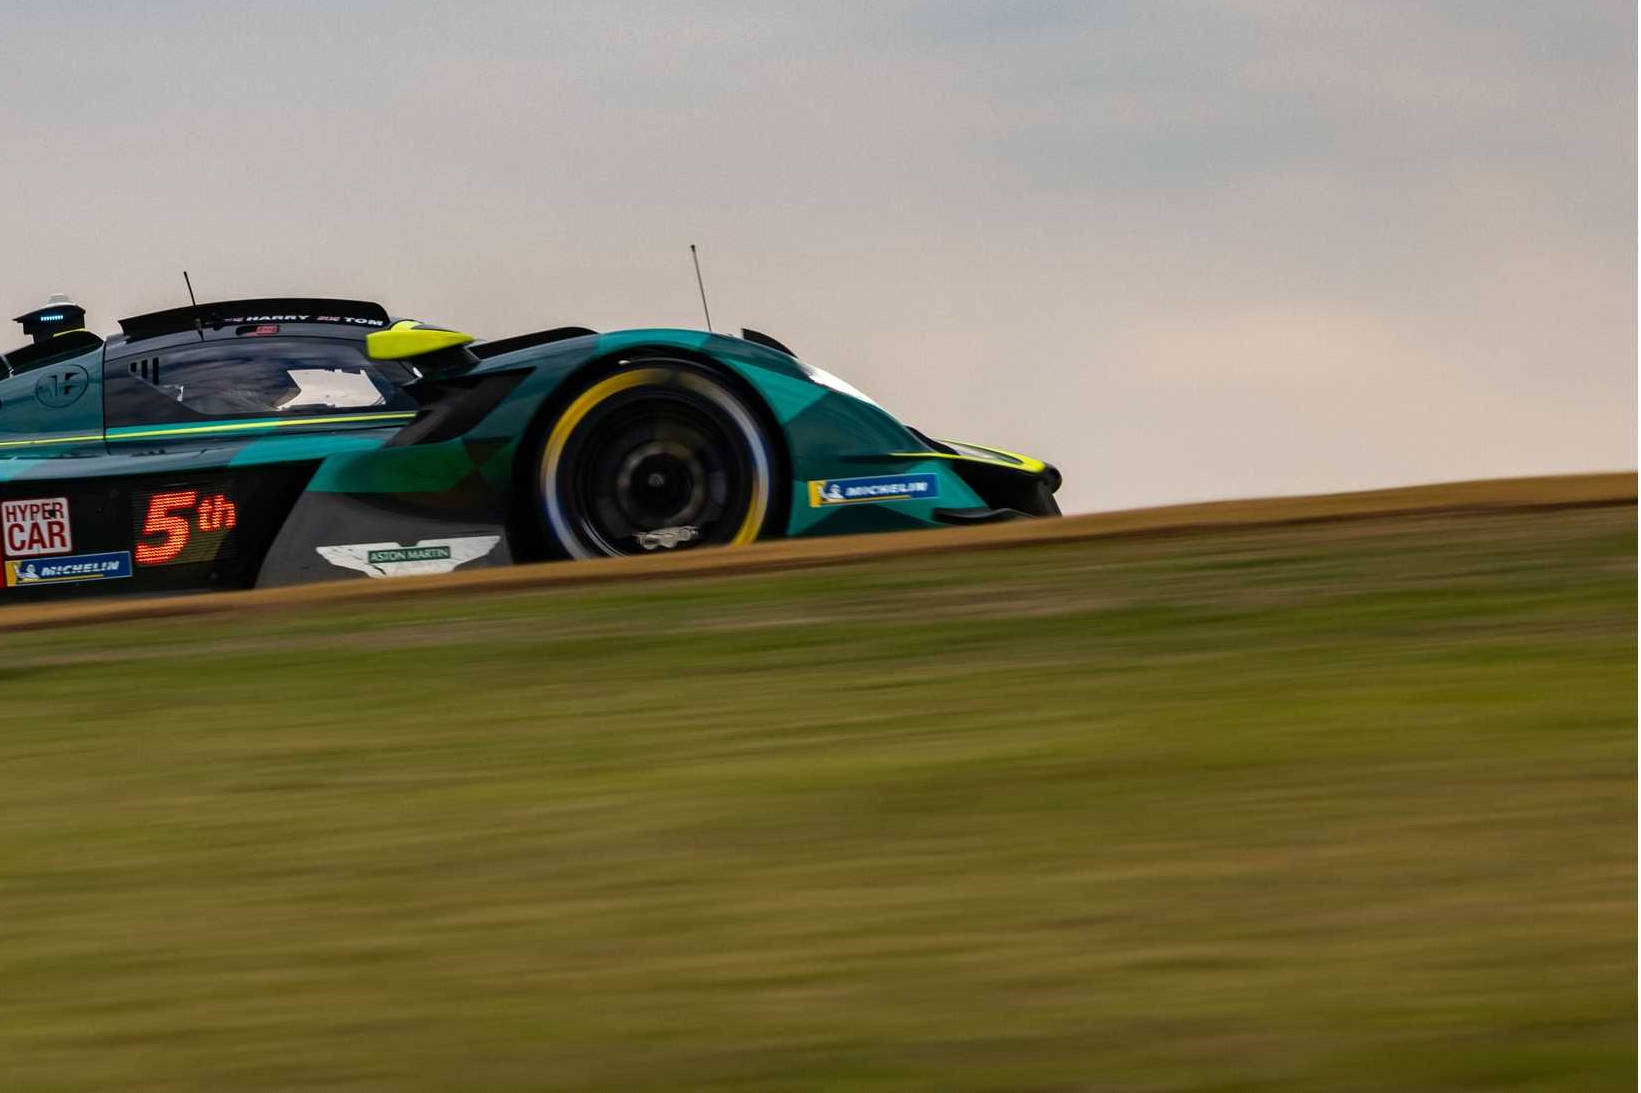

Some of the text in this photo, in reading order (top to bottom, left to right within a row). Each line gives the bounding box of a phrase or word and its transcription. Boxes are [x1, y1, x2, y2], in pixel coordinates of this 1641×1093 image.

[343, 317, 383, 326] TOM
[6, 502, 64, 523] HYPER
[9, 520, 68, 552] CAR
[135, 491, 236, 565] 5th
[371, 548, 448, 562] ASTON MARTIN
[41, 560, 119, 576] MICHELIN
